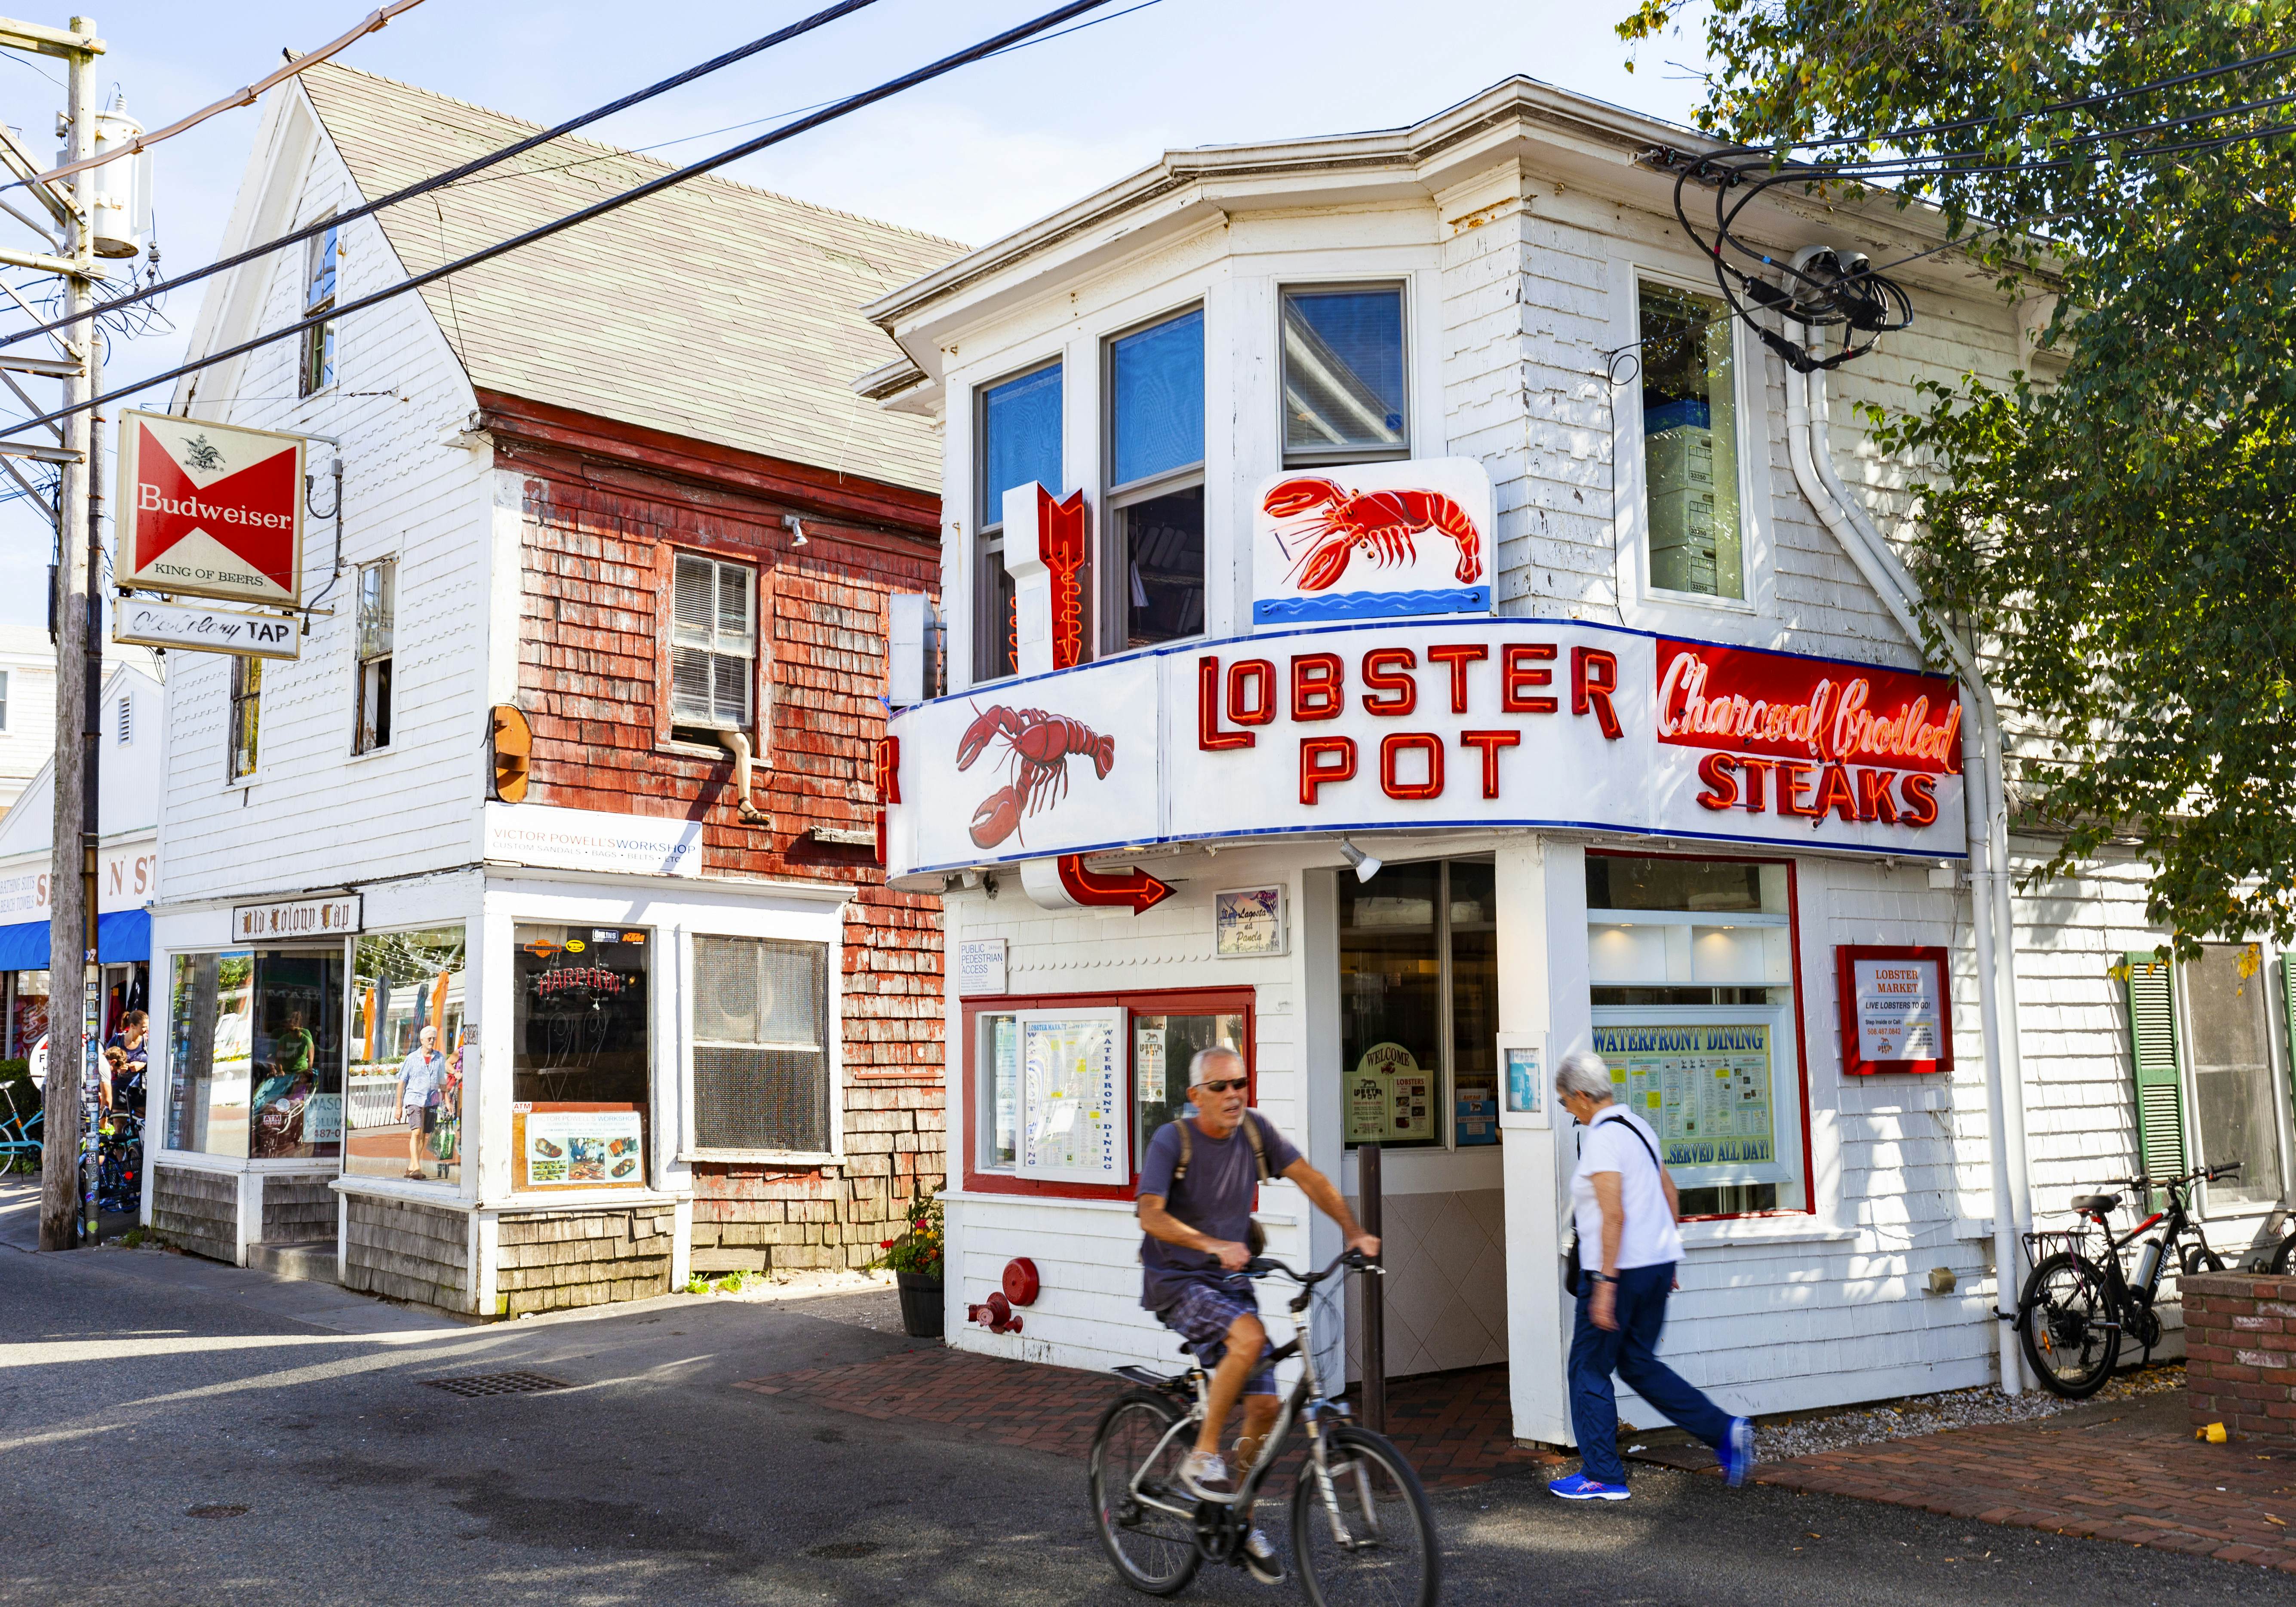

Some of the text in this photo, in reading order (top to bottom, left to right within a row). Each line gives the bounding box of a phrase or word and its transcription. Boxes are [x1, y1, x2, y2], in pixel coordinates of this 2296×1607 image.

[1690, 472, 1706, 481] 33250
[138, 483, 291, 530] Budweiser
[155, 563, 264, 586] KING OF BEERS
[1692, 584, 1708, 592] 33250
[246, 621, 289, 642] TAP
[1199, 643, 1624, 751] LOBSTER
[1657, 652, 1963, 774] Charcoal Broiled
[1300, 730, 1520, 805] POT
[1697, 752, 1939, 828] STEAKS
[494, 828, 545, 842] VICTOR
[493, 841, 534, 851] CUSTOM
[537, 845, 581, 855] SANDALS
[592, 850, 617, 858] BAGS
[628, 853, 655, 861] BELTS
[0, 876, 35, 894] BATHING SUITS
[0, 895, 34, 913] BEACH TOWELS
[243, 909, 264, 939] Old
[270, 904, 315, 936] Colony
[622, 932, 645, 942] KTM
[962, 943, 985, 953] PUBLIC
[962, 953, 1002, 964] PEDESTRIAN
[962, 964, 988, 974] ACCESS
[1875, 969, 1918, 980] LOBSTER
[539, 968, 620, 997] HARPOON
[1878, 983, 1918, 993] MARKET
[464, 1026, 477, 1044] 323
[1592, 1025, 1764, 1053] WATERFRONT DINING
[1367, 1047, 1410, 1067] WELCOME
[1102, 1029, 1113, 1113] WATERFRONT
[1103, 1124, 1112, 1170] DINING
[1718, 1141, 1740, 1161] ALL
[1742, 1139, 1769, 1161] DAY!
[2154, 1243, 2172, 1287] ANCHEER
